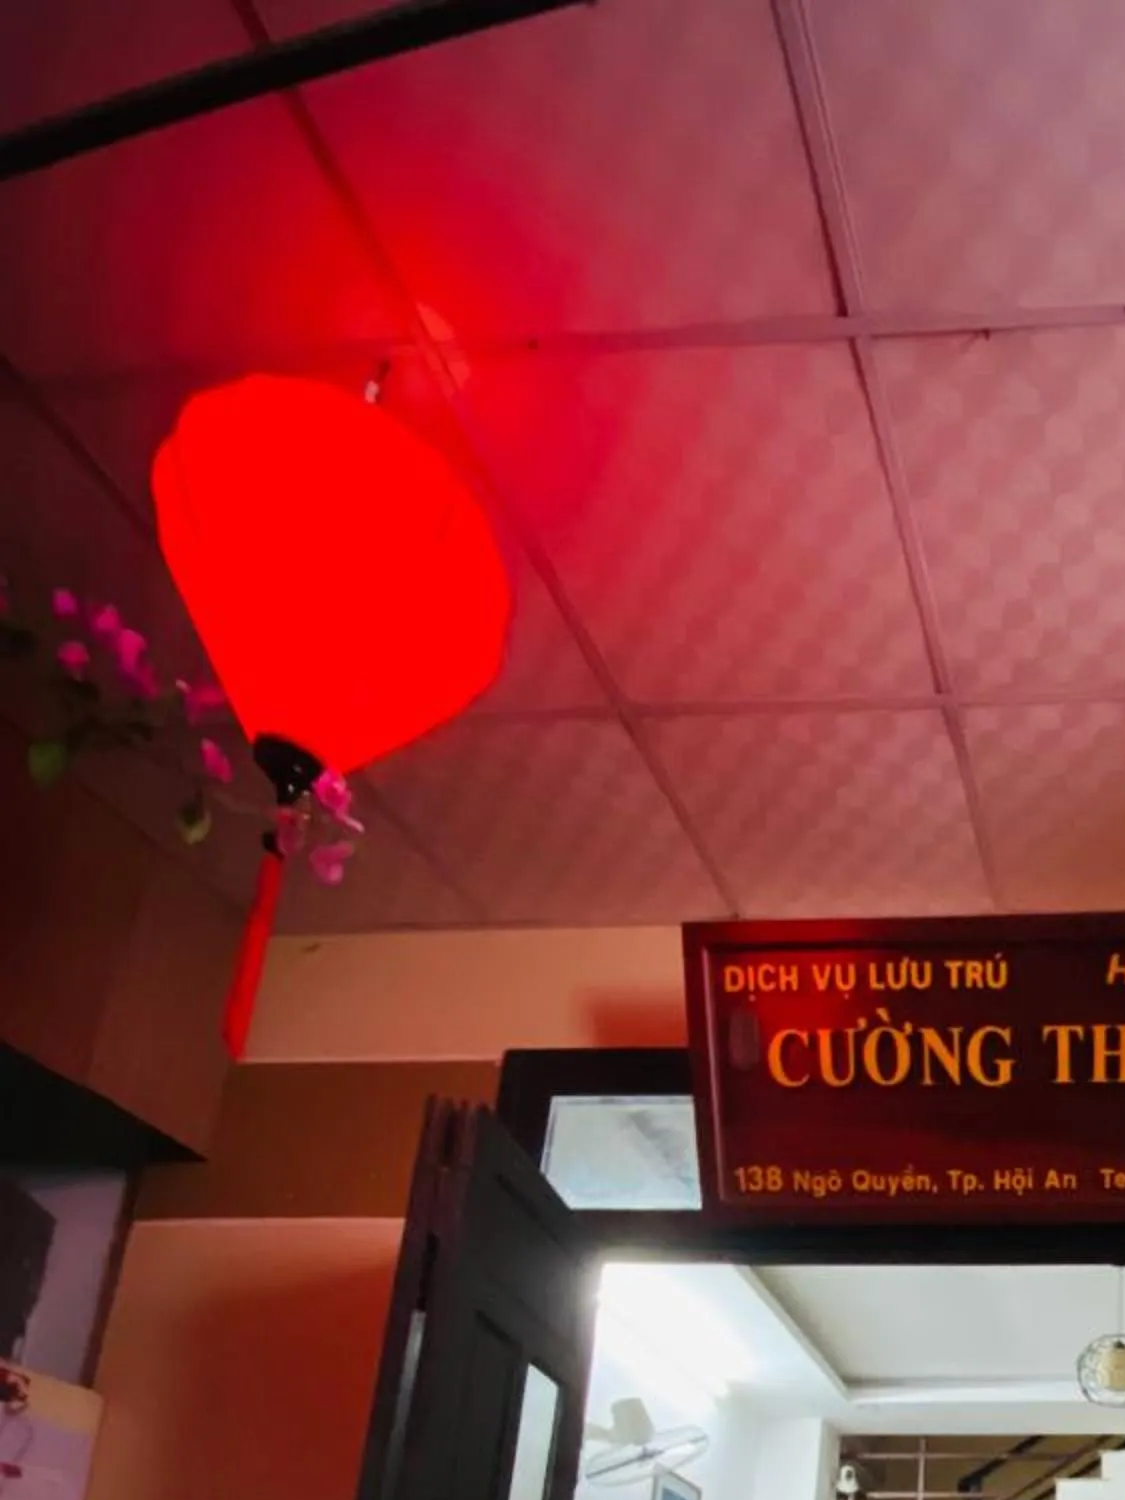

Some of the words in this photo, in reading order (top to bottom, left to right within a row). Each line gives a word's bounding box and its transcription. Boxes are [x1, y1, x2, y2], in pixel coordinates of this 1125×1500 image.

[724, 964, 798, 1002] DỊCH
[812, 963, 857, 1000] VỤ
[868, 956, 932, 991] LƯU
[944, 951, 1008, 990] TRÚ
[767, 1007, 1016, 1088] CƯỜNG
[792, 1168, 843, 1199] Ngô
[946, 1168, 985, 1195] Tp.
[994, 1167, 1034, 1196] Hội
[1044, 1168, 1078, 1190] An
